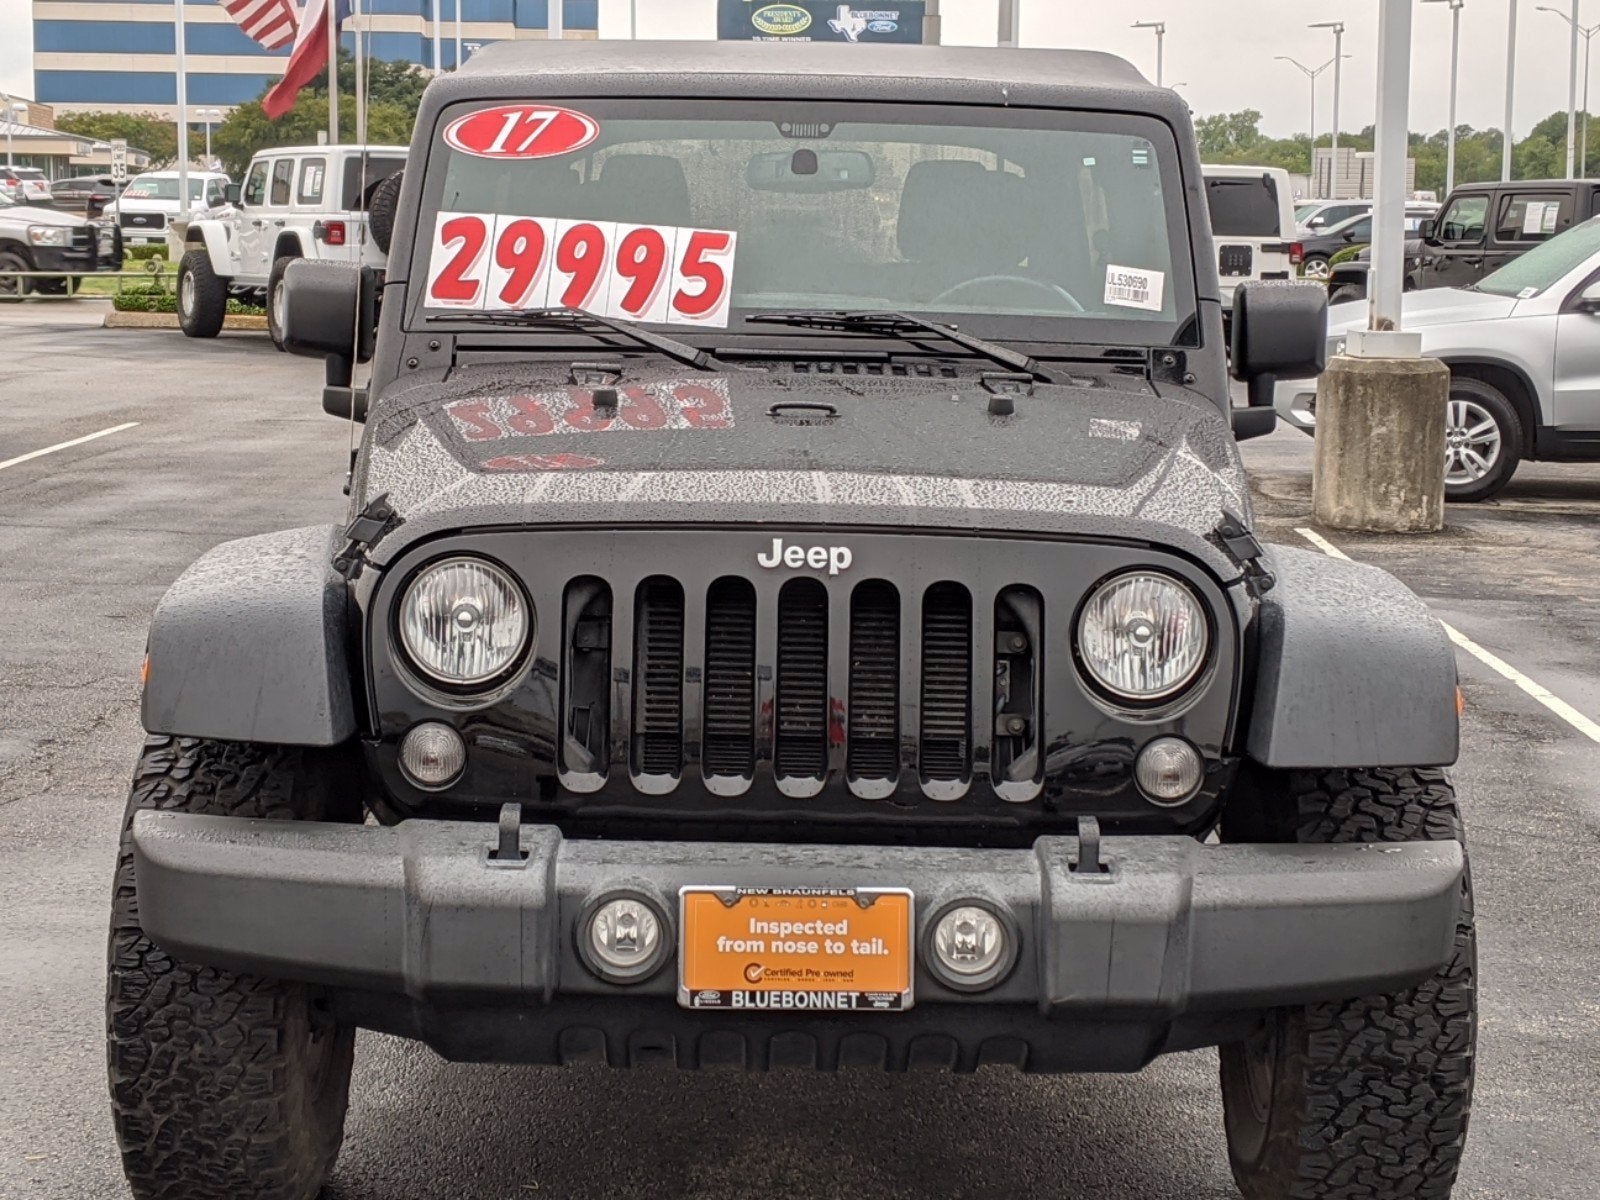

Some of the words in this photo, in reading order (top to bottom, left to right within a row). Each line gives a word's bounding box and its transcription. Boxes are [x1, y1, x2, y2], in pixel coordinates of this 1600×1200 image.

[483, 110, 560, 154] 17
[113, 163, 126, 179] 35
[430, 215, 731, 320] 29995
[757, 538, 853, 575] Jeep
[772, 888, 856, 896] BRAUNFELS
[749, 917, 848, 937] Inspected
[716, 936, 765, 953] from
[771, 940, 819, 954] nose
[824, 939, 845, 954] to
[850, 938, 889, 955] tail.
[764, 968, 803, 977] Certified
[732, 991, 860, 1009] BLUEBONNET
